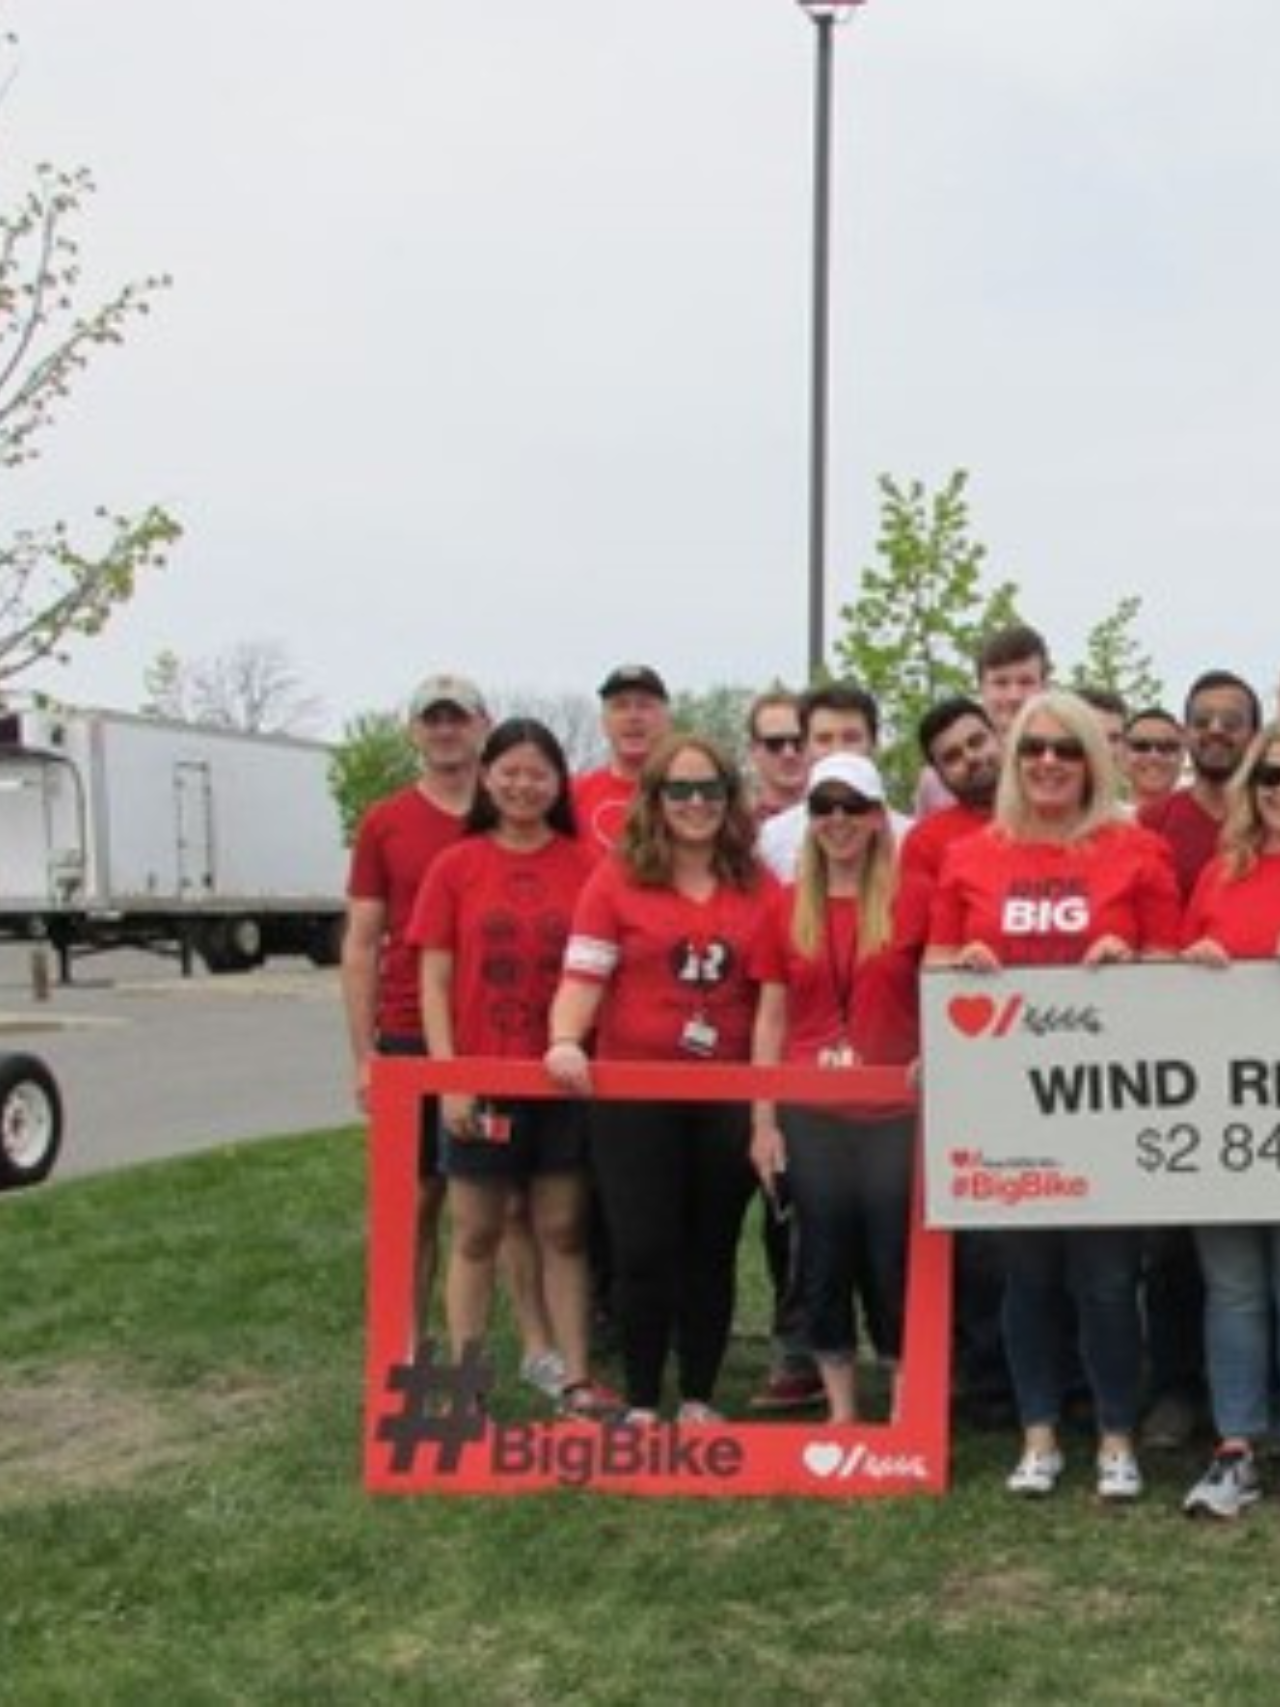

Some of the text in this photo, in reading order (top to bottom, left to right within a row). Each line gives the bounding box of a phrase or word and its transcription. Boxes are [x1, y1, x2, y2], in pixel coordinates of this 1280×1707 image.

[1002, 897, 1090, 933] BIG
[1029, 1060, 1197, 1115] WIND
[1135, 1122, 1200, 1172] $2
[952, 1171, 1088, 1205] #BigBike
[376, 1340, 744, 1484] #BigBike
